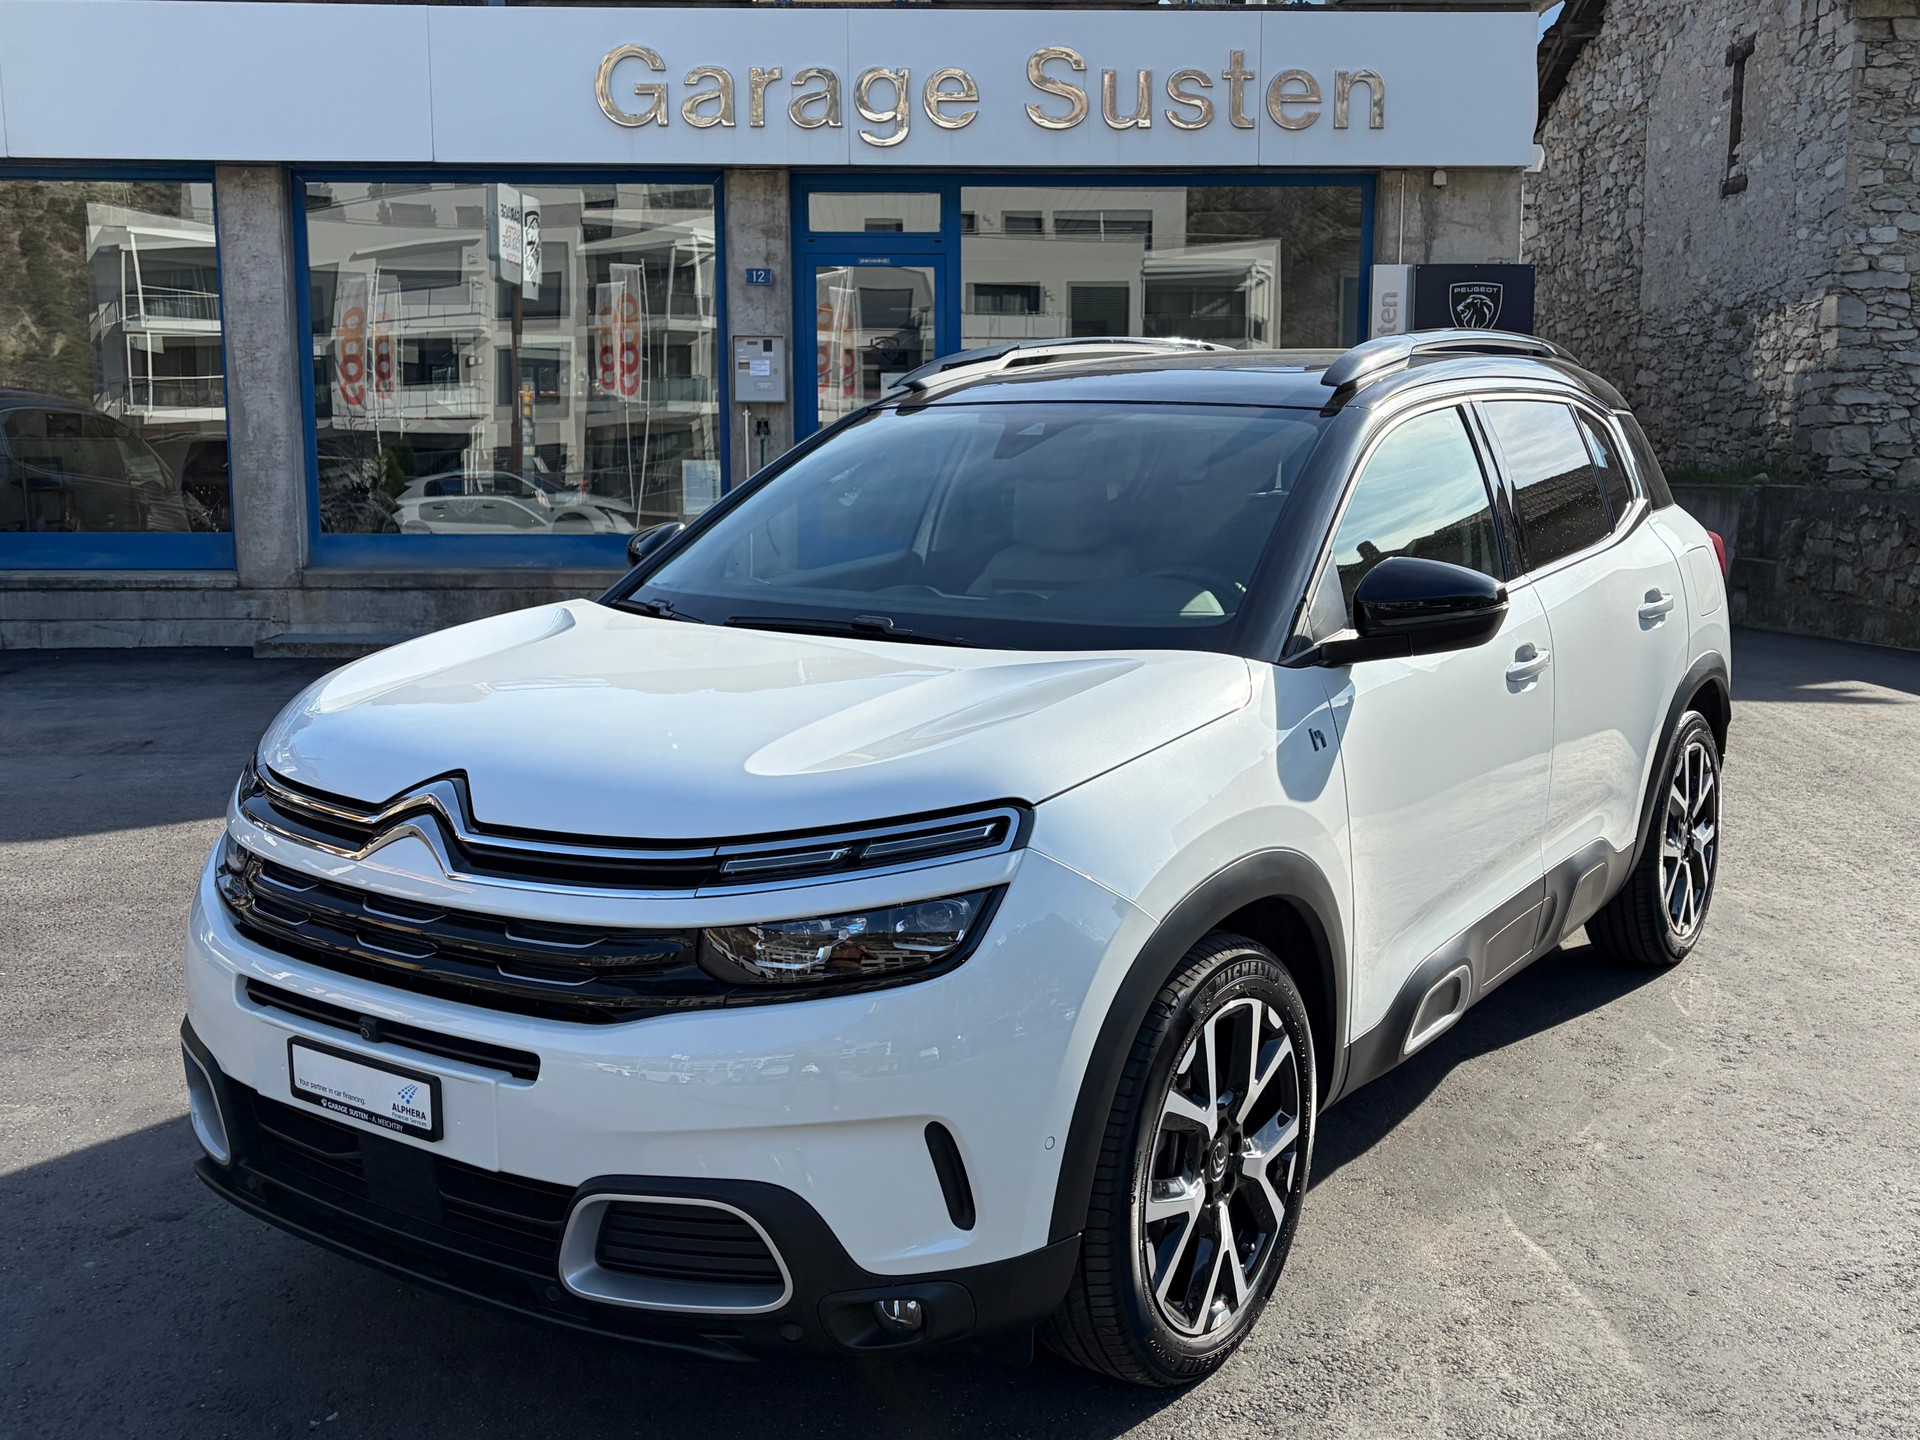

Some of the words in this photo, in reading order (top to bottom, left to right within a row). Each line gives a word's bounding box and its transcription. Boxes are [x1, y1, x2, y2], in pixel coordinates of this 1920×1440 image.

[594, 43, 979, 147] Garage
[1025, 45, 1385, 132] Susten
[752, 270, 765, 283] 12
[1214, 961, 1281, 990] MICHELIN
[299, 1077, 309, 1086] Your
[310, 1082, 327, 1092] partner
[327, 1101, 348, 1114] GARAGE
[349, 1108, 369, 1120] SUSTEN
[371, 1116, 378, 1124] A.
[377, 1118, 404, 1132] MEICHTRY
[392, 1103, 426, 1120] ALPHERA
[392, 1112, 409, 1123] Financial
[410, 1117, 427, 1128] Services
